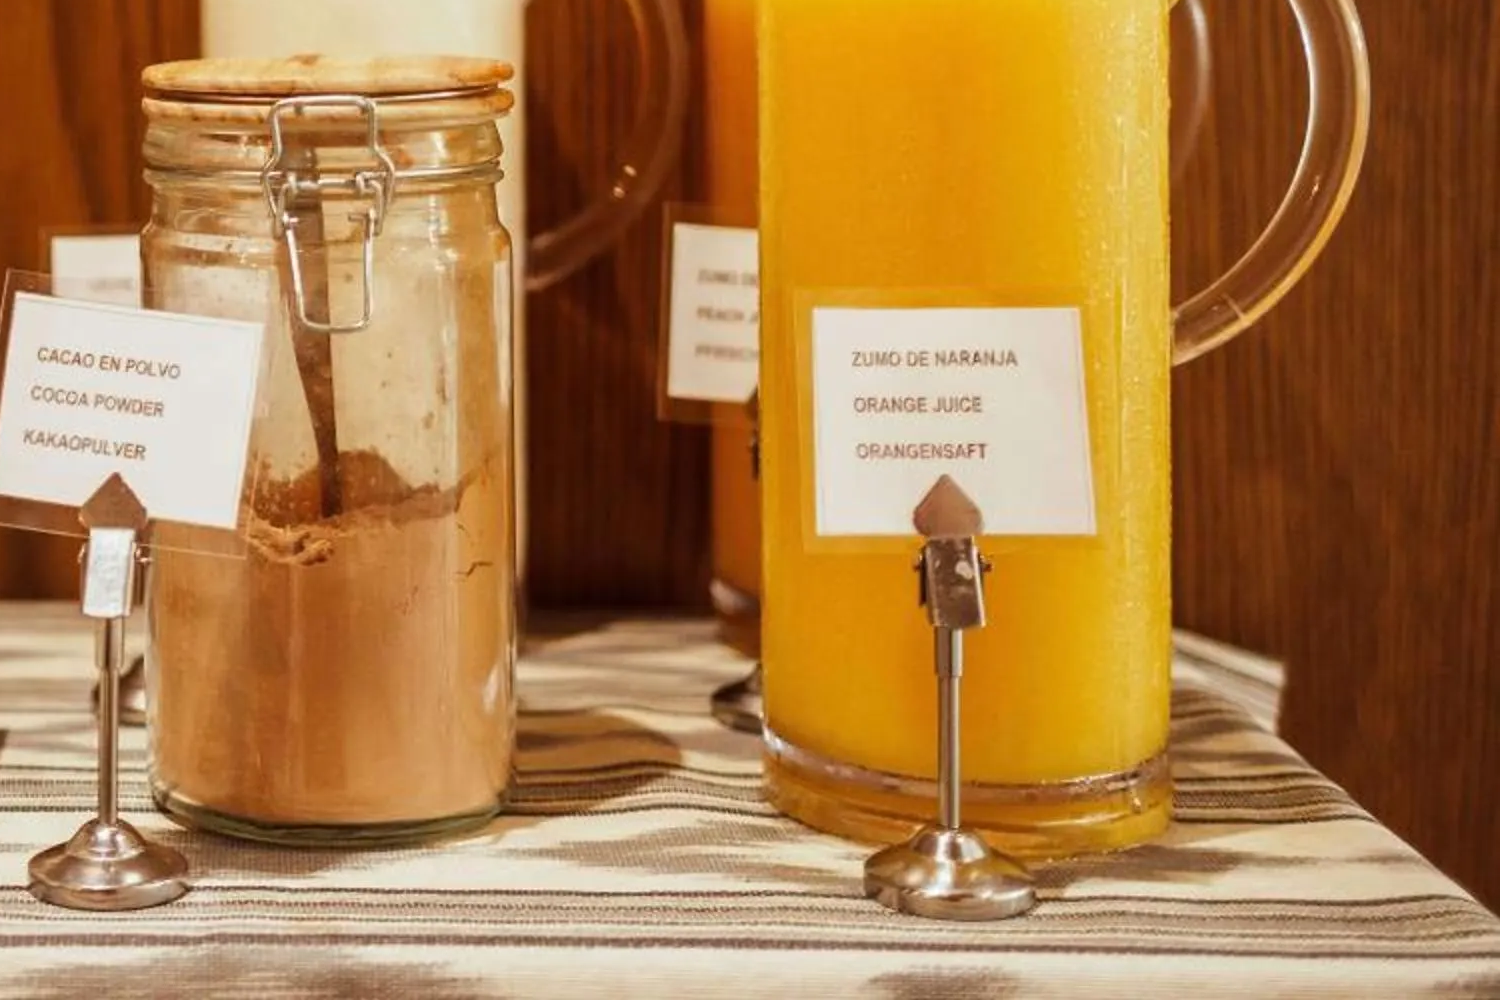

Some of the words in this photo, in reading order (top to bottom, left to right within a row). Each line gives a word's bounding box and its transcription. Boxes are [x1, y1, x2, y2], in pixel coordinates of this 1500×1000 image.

[36, 346, 95, 370] CACAO
[99, 354, 122, 372] EN
[124, 357, 182, 380] POLVO
[851, 350, 902, 368] ZUMO
[906, 350, 930, 368] DE
[934, 349, 1019, 368] NARANJA
[30, 384, 90, 407] COCOA
[93, 393, 165, 418] POWDER
[853, 395, 928, 414] ORANGE
[932, 395, 983, 414] JUICE
[22, 428, 147, 461] KAKAOPULVER
[855, 442, 988, 460] ORANGENSAFT
